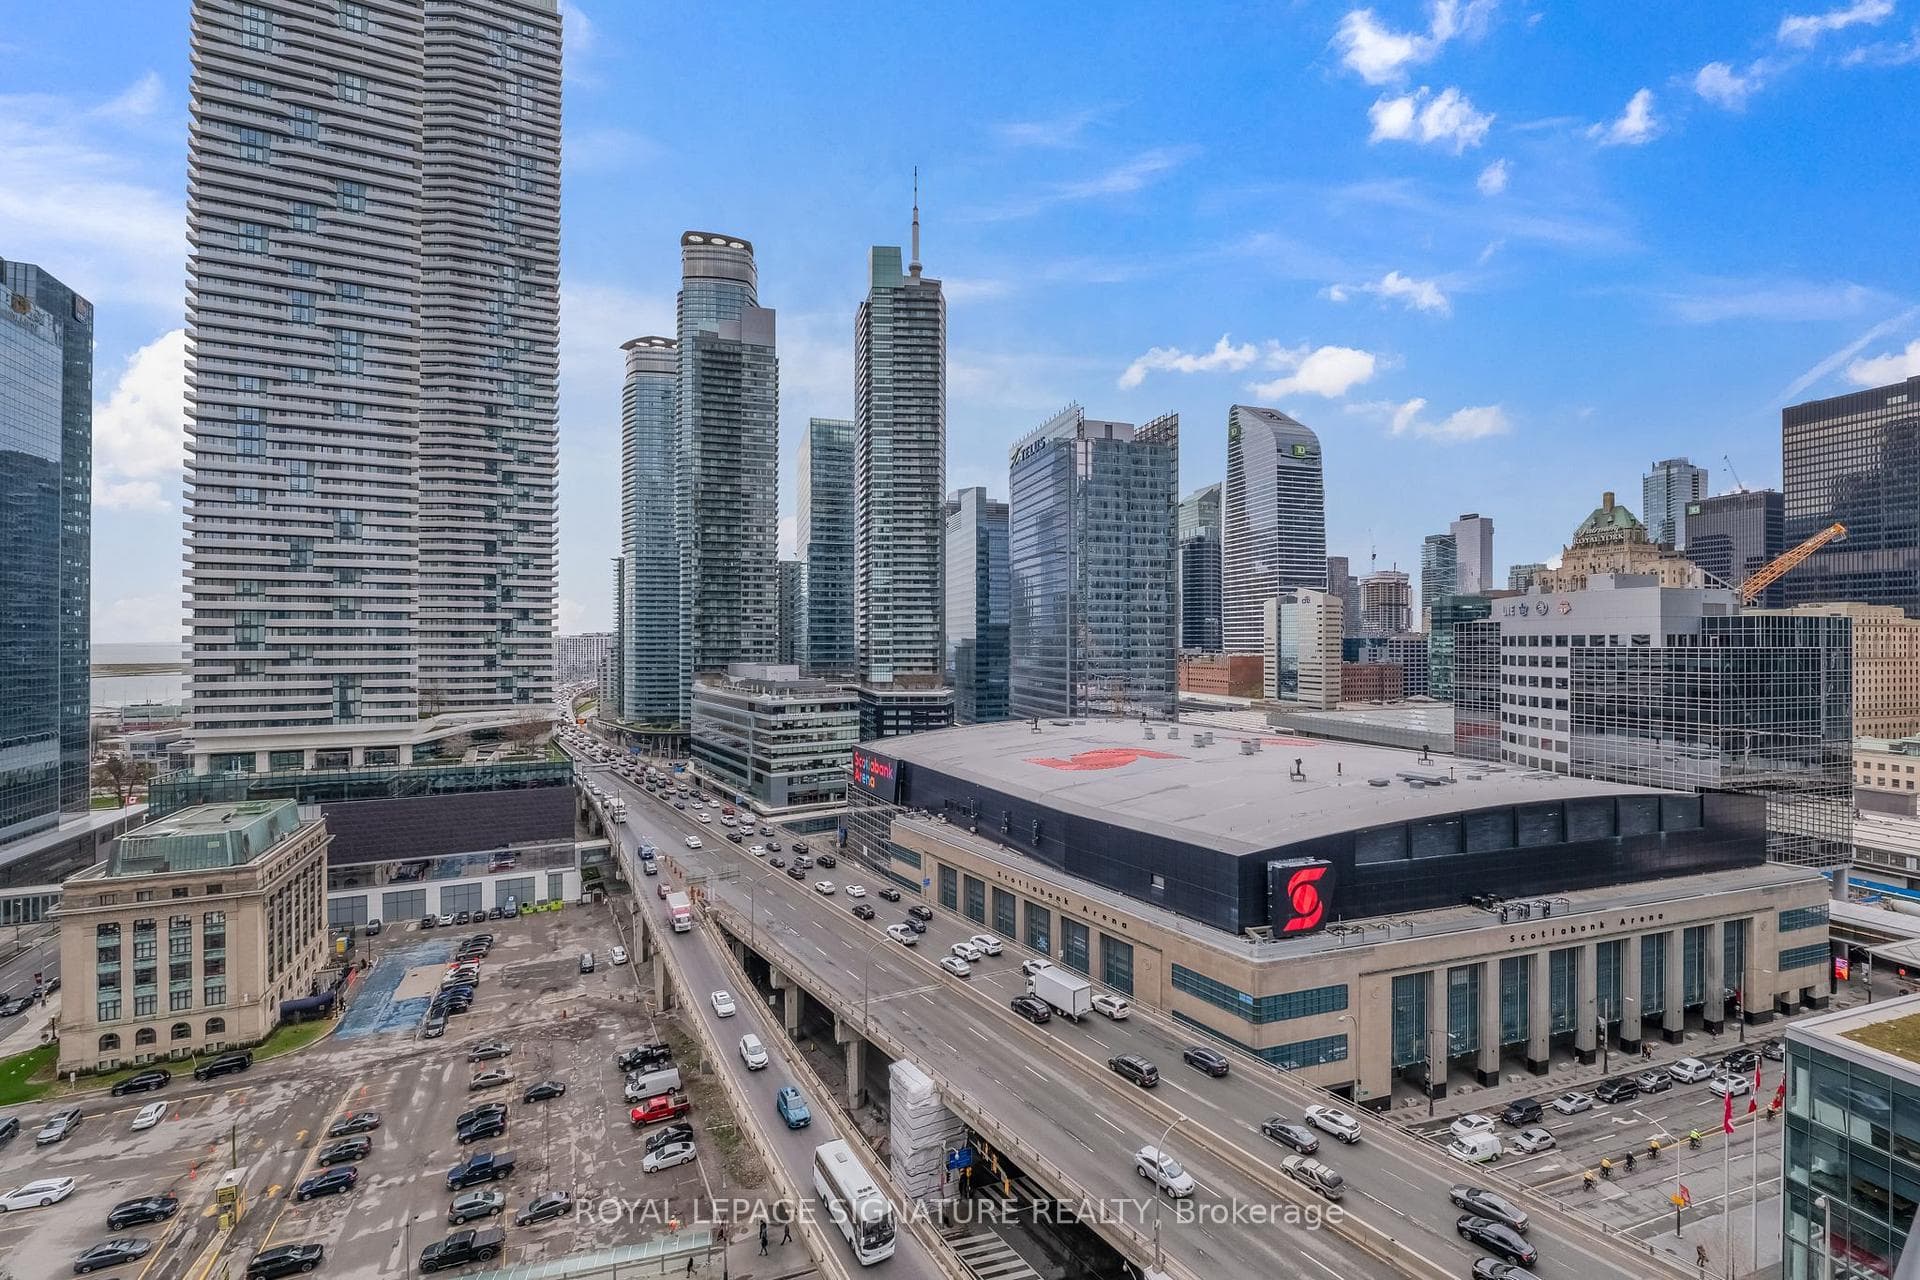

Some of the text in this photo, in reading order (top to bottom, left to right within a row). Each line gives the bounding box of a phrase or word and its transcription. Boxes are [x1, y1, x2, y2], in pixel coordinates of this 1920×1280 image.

[1021, 436, 1046, 461] TELUS
[1600, 532, 1624, 542] YORK
[997, 871, 1127, 929] Scotiabank Arena
[1509, 912, 1664, 943] Scotiabank Arena
